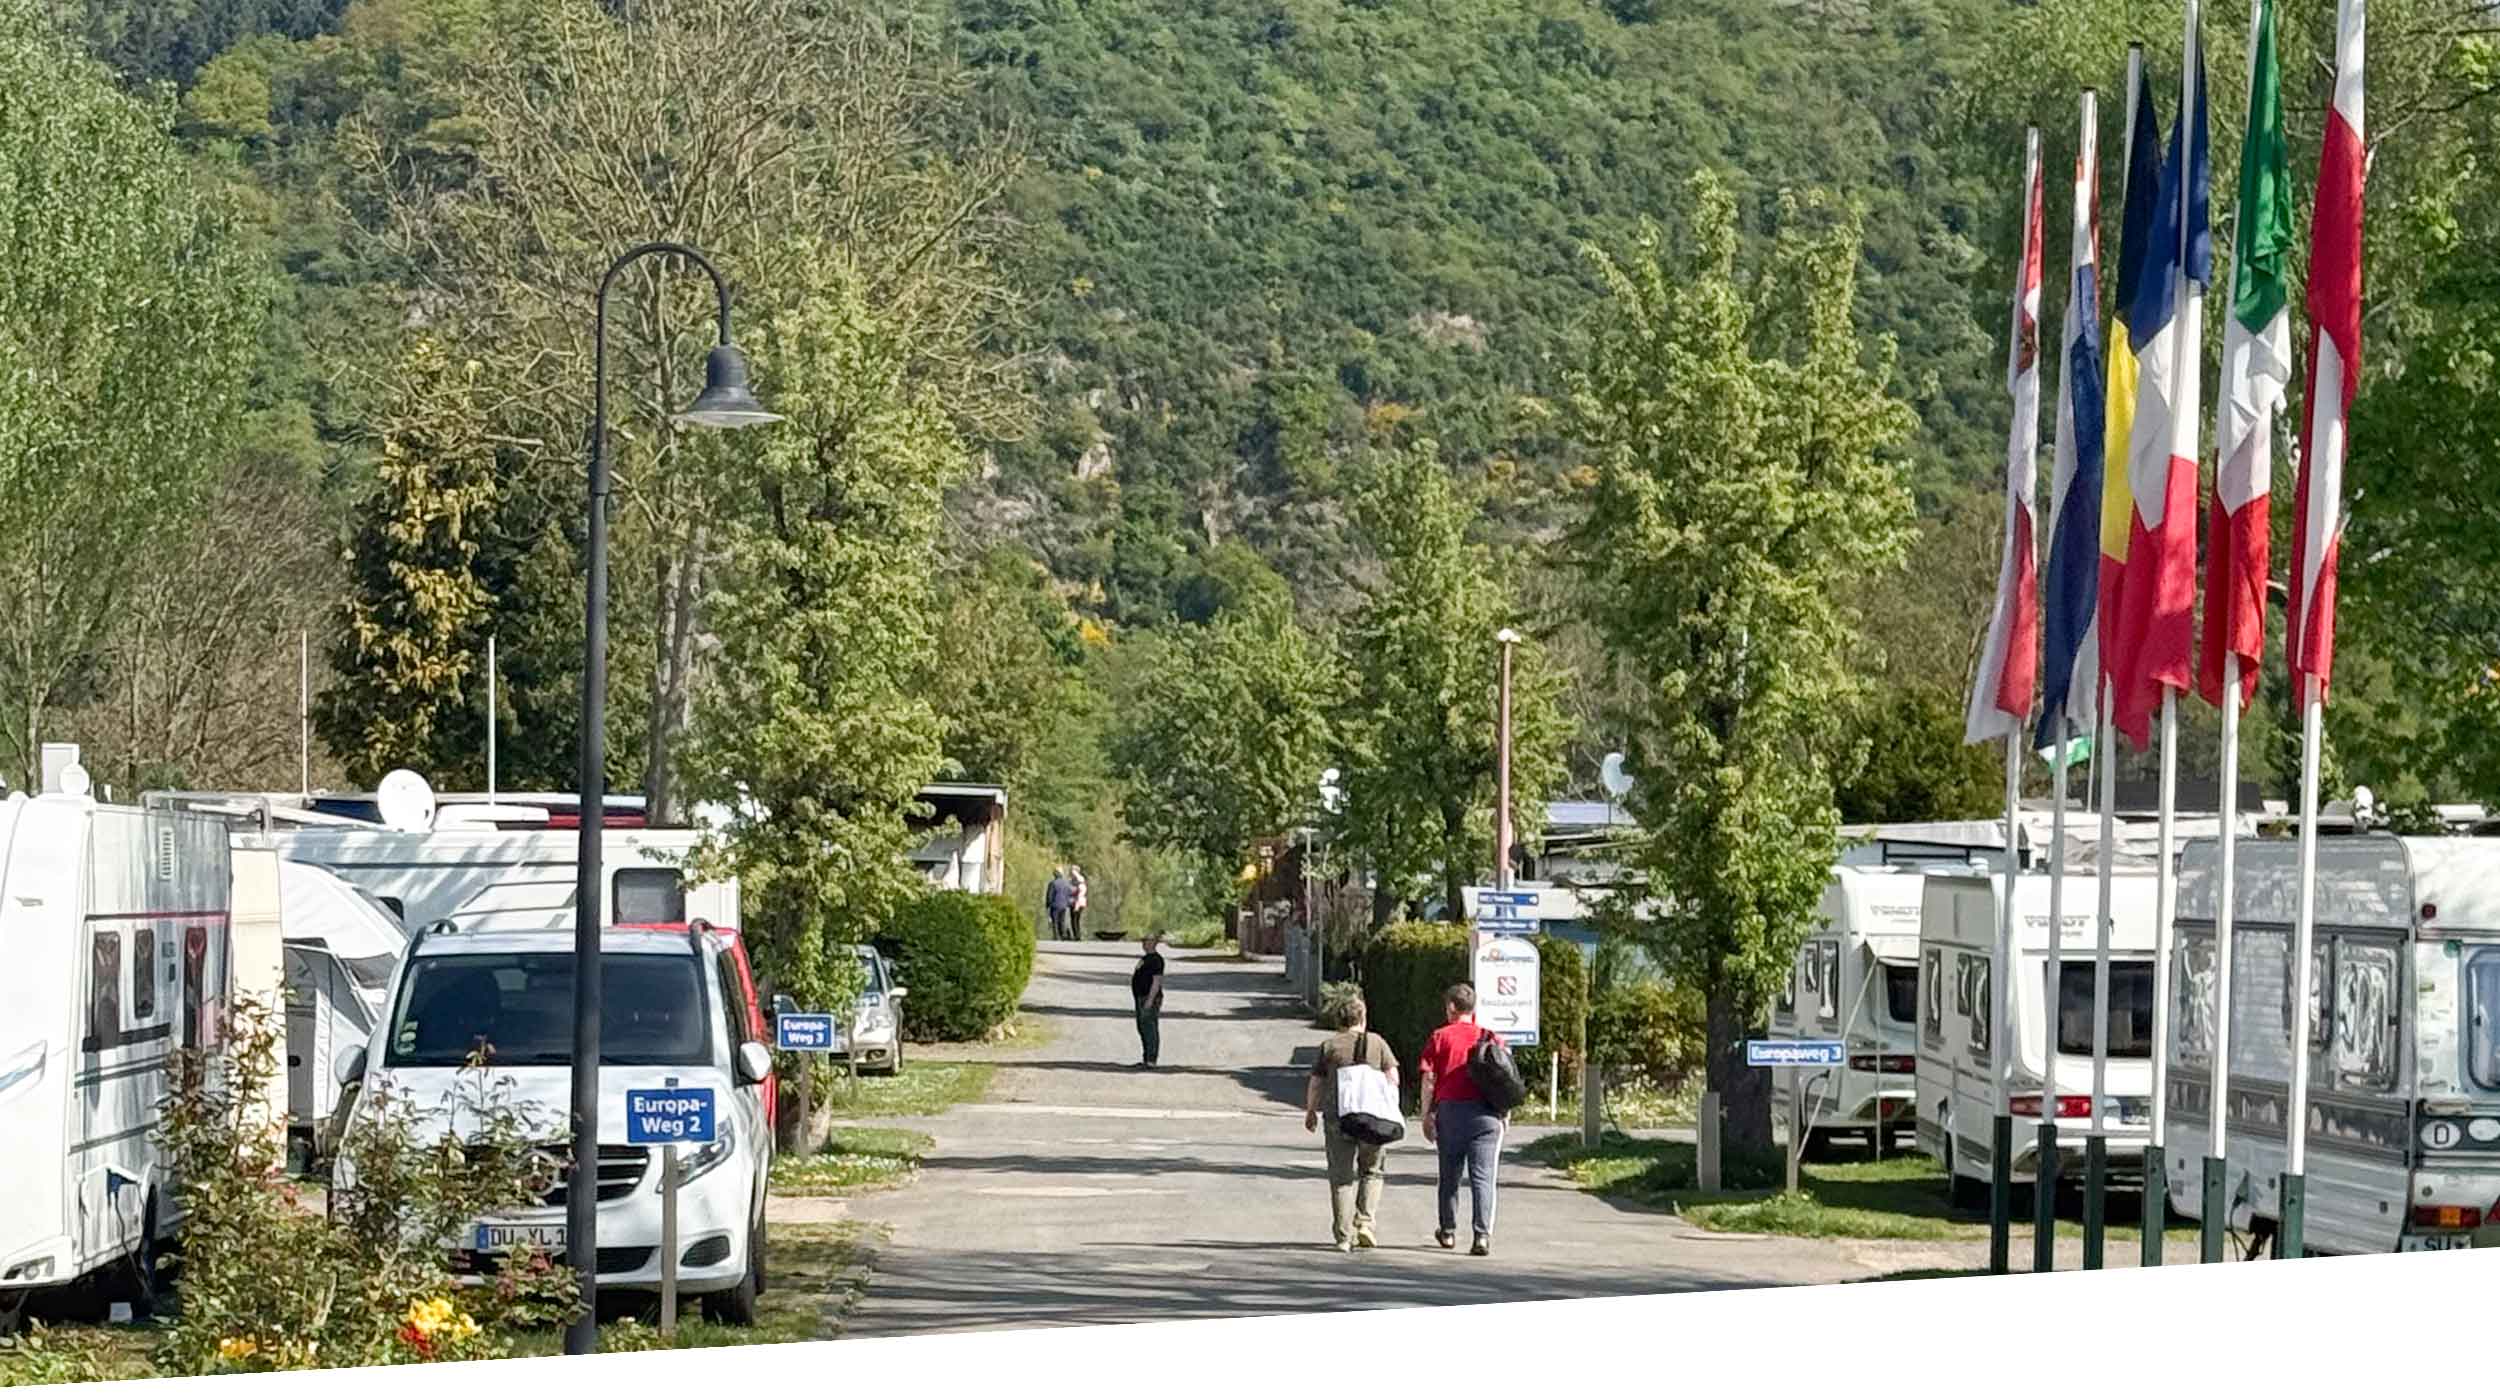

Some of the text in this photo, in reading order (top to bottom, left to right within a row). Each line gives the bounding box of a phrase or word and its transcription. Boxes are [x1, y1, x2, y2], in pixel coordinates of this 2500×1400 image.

[783, 1019, 828, 1032] Europa-
[788, 1032, 824, 1045] Weg 3
[1751, 1046, 1842, 1062] Europaweg 3
[633, 1097, 708, 1116] Europa-
[641, 1115, 702, 1137] Weg 2
[491, 1228, 514, 1246] DU
